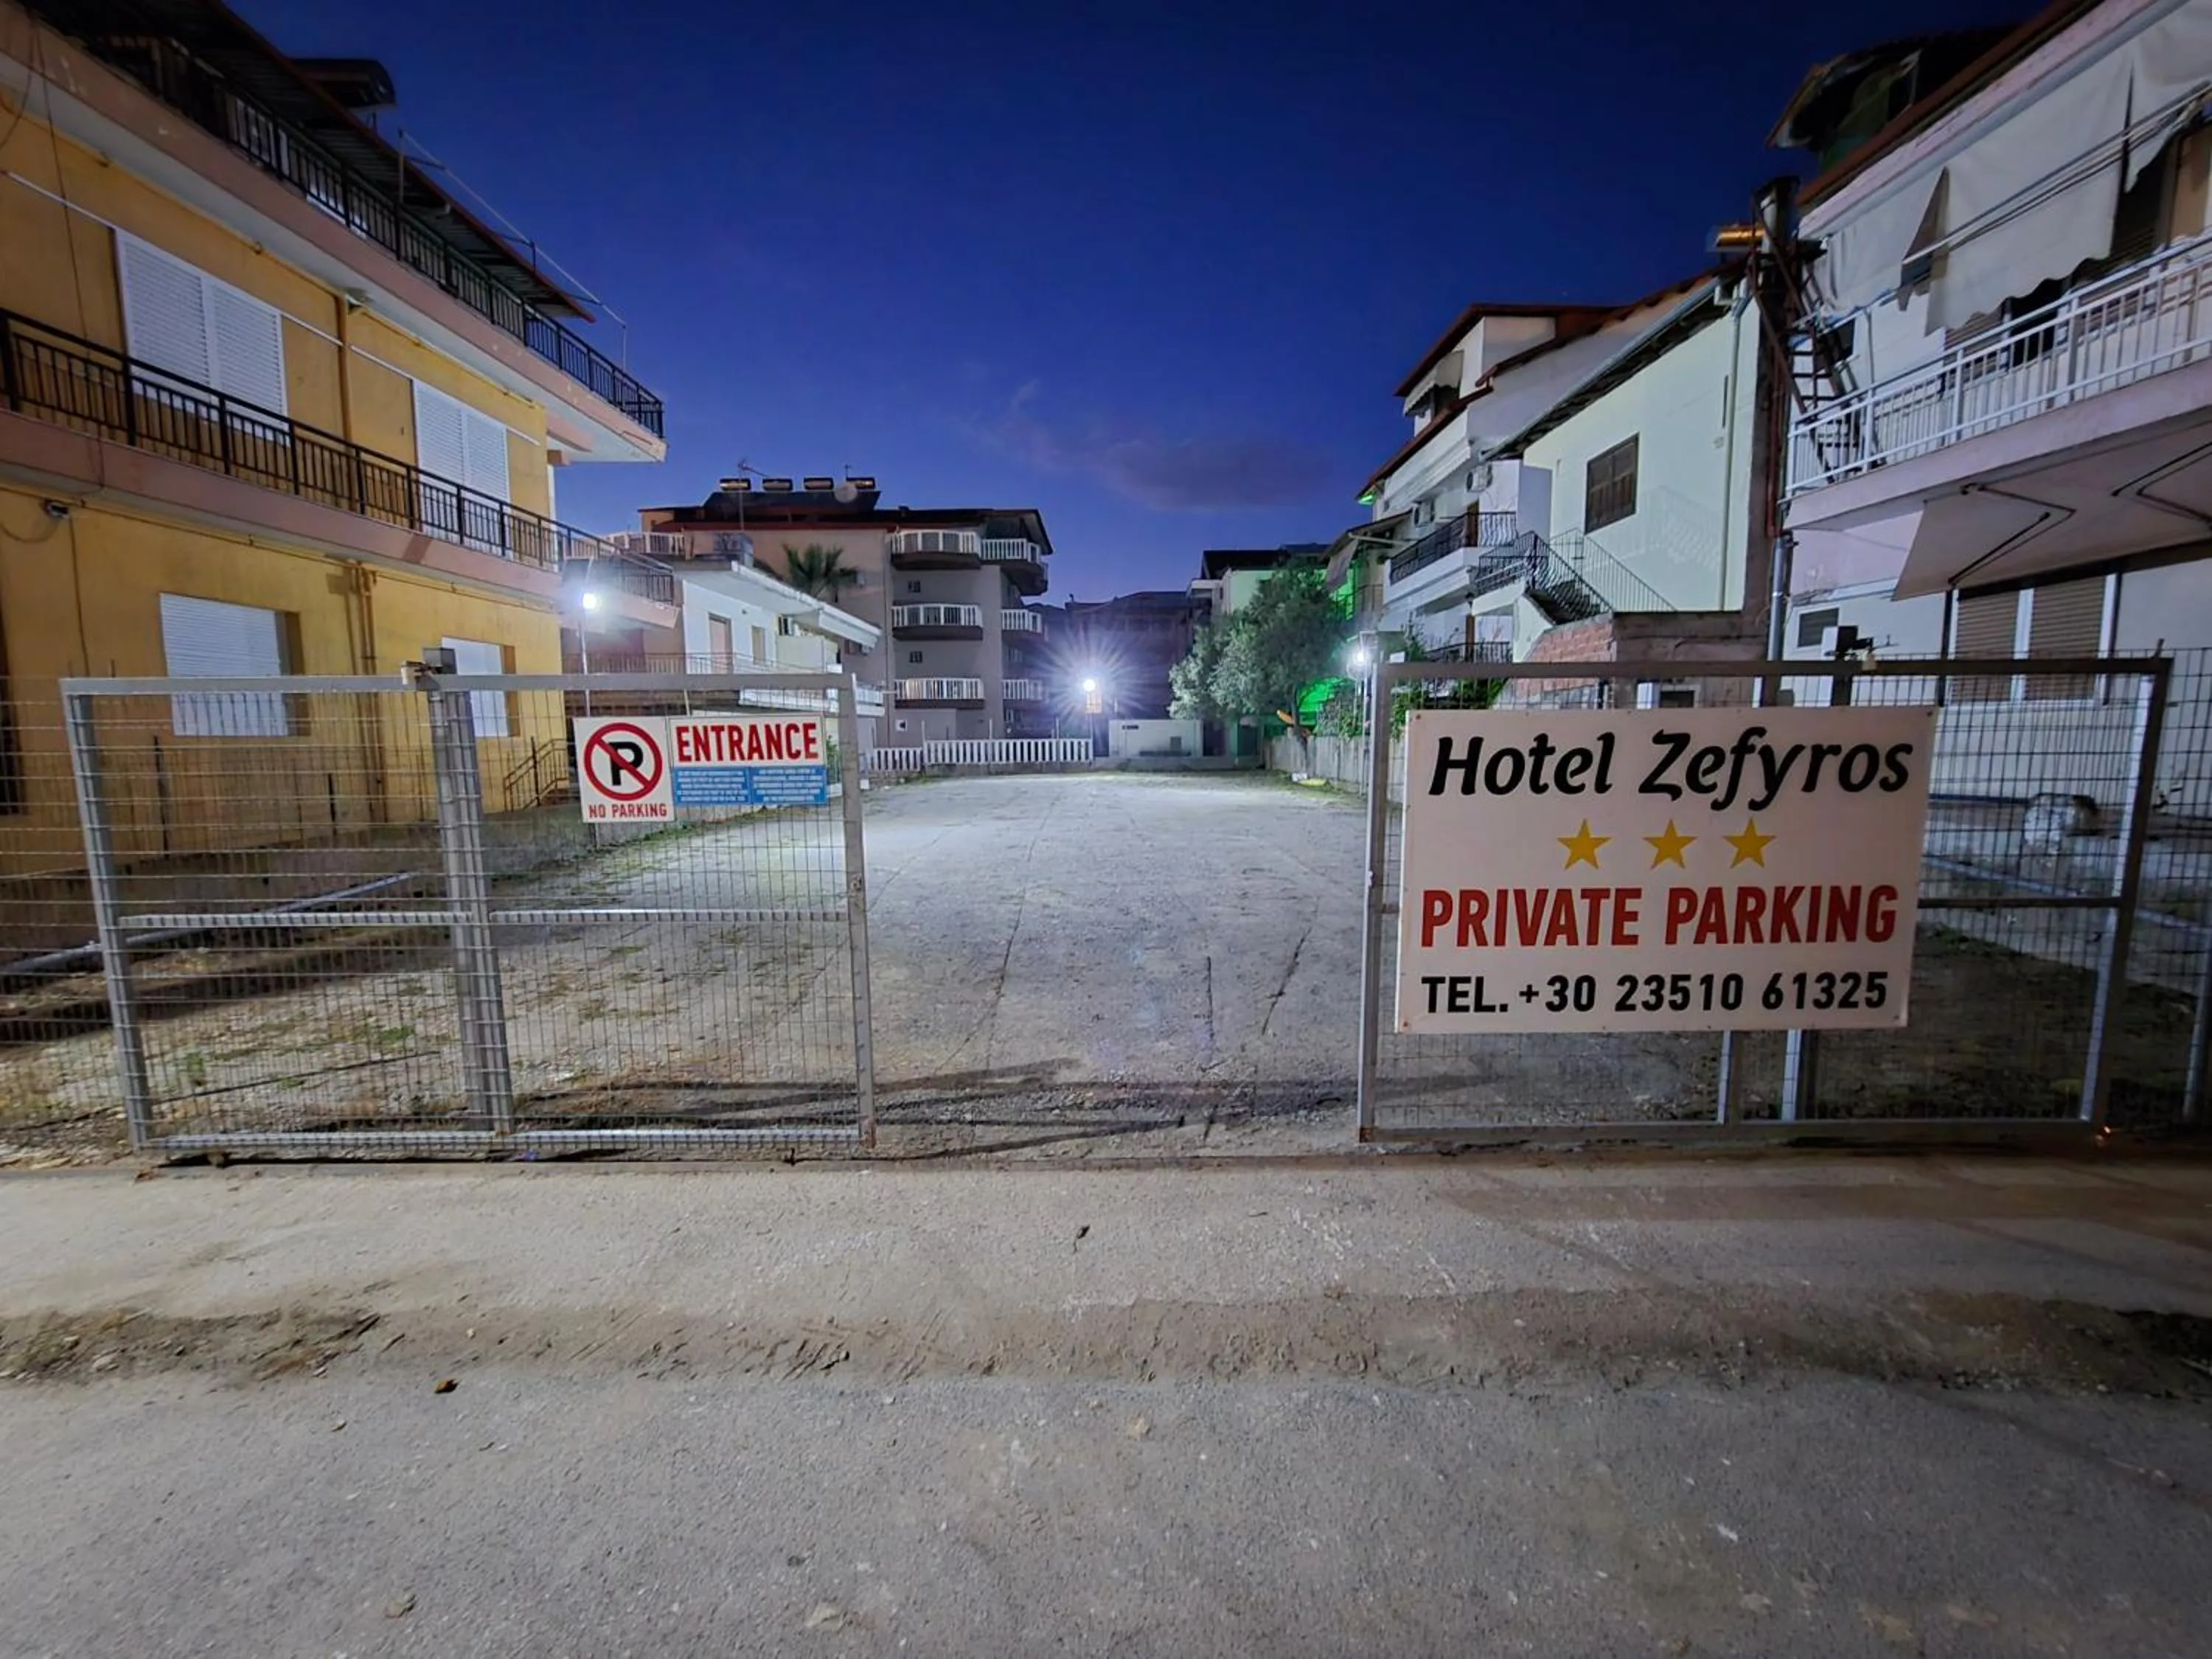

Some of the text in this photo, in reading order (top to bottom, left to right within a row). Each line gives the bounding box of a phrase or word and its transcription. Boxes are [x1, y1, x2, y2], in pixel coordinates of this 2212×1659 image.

[675, 722, 818, 762] ENTRANCE
[1428, 726, 1913, 812] Hotel Zefyros
[589, 804, 667, 818] NO PARKING
[1421, 885, 1899, 947] PRIVATE PARKING
[1421, 971, 1888, 1014] TEL. +30 23510 61325
